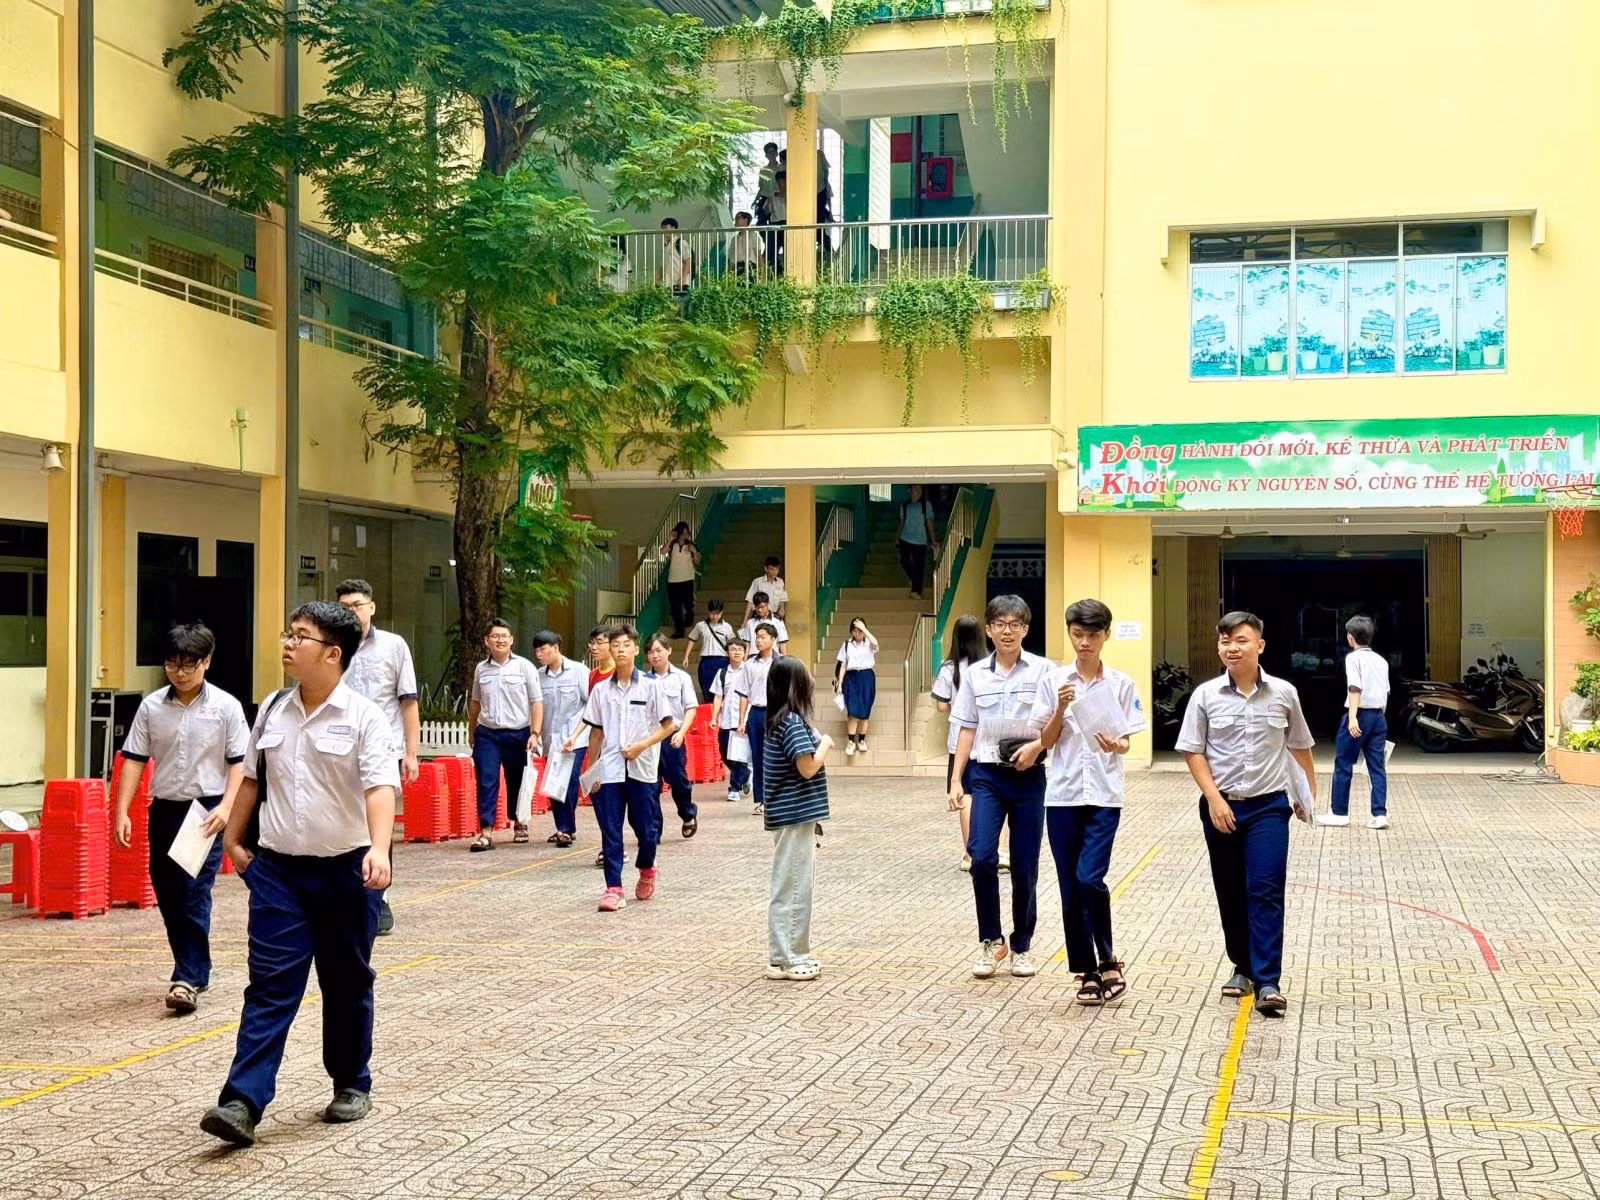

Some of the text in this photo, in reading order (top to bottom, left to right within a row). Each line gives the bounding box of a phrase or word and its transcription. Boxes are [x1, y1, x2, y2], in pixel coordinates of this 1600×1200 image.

[1100, 436, 1175, 464] Đồng
[1182, 440, 1234, 457] HÀNH
[1240, 435, 1274, 456] ĐỔI
[1325, 435, 1352, 455] KẾ
[1359, 437, 1411, 454] THỪA
[1417, 435, 1441, 453] VÀ
[1447, 435, 1501, 453] PHÁT
[1507, 429, 1568, 451] TRIỂN
[1100, 473, 1166, 494] Khởi
[1174, 477, 1222, 495] ĐỘNG
[1257, 475, 1329, 491] NGUYÊN
[1368, 472, 1418, 489] CÙNG
[1423, 469, 1460, 489] THẾ
[1465, 470, 1490, 491] HỆ
[1497, 471, 1558, 487] TƯƠNG
[1565, 472, 1594, 486] LAI
